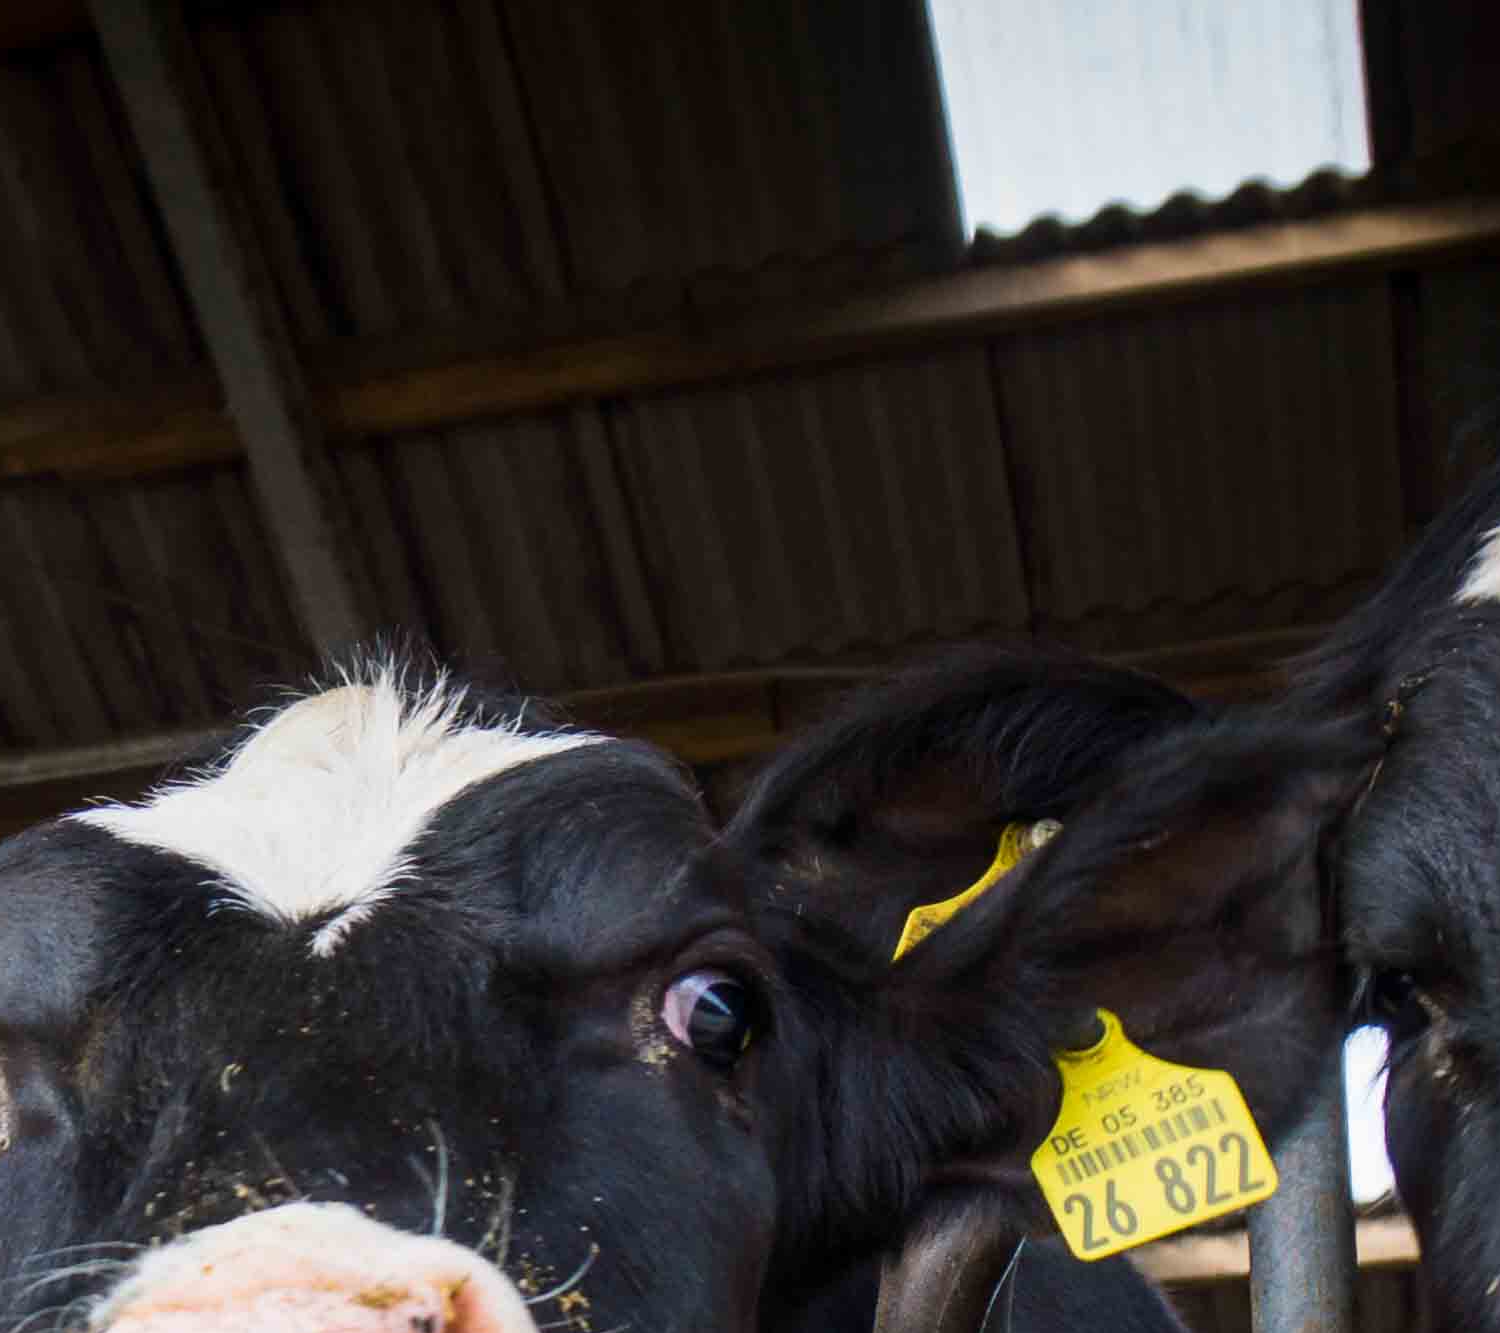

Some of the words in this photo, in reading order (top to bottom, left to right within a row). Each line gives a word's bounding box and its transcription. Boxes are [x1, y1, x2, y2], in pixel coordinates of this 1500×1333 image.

[1051, 1127, 1089, 1156] DE
[1102, 1105, 1137, 1135] 05
[1152, 1073, 1205, 1112] 385
[1063, 1179, 1138, 1250] 26
[1155, 1131, 1265, 1214] 822
